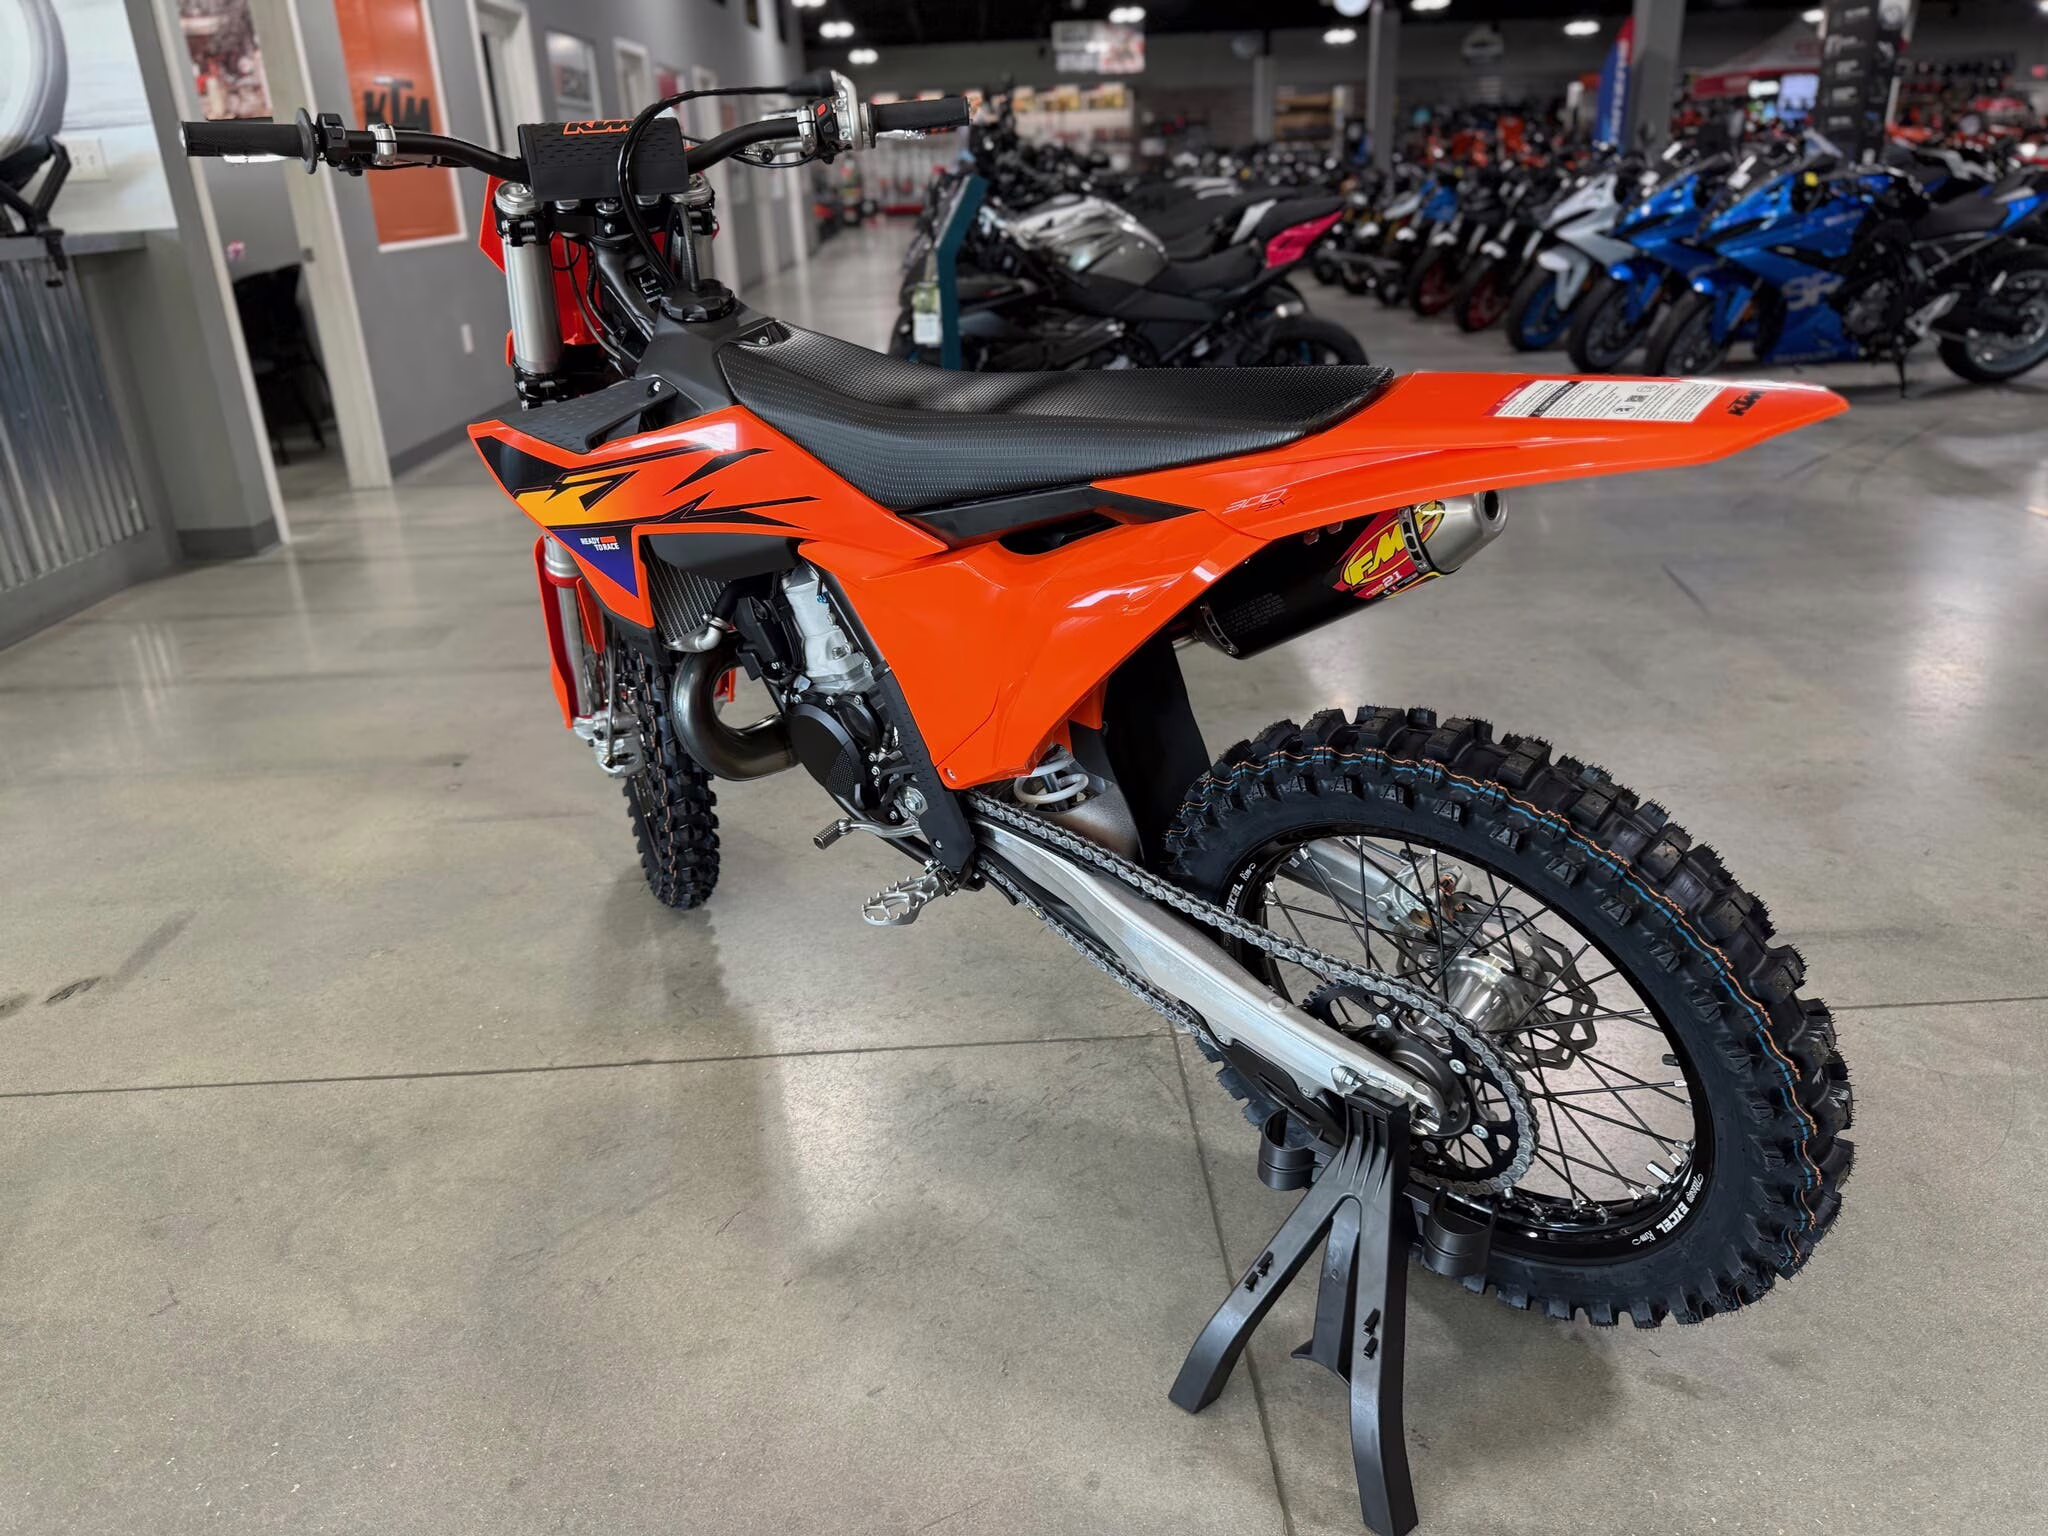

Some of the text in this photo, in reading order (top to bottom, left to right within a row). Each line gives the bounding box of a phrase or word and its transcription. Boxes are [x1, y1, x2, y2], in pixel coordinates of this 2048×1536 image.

[1222, 488, 1288, 514] 300
[580, 536, 600, 546] READY
[602, 543, 620, 551] RACE
[1348, 499, 1438, 587] FMF
[1656, 1201, 1690, 1233] EXCEL
